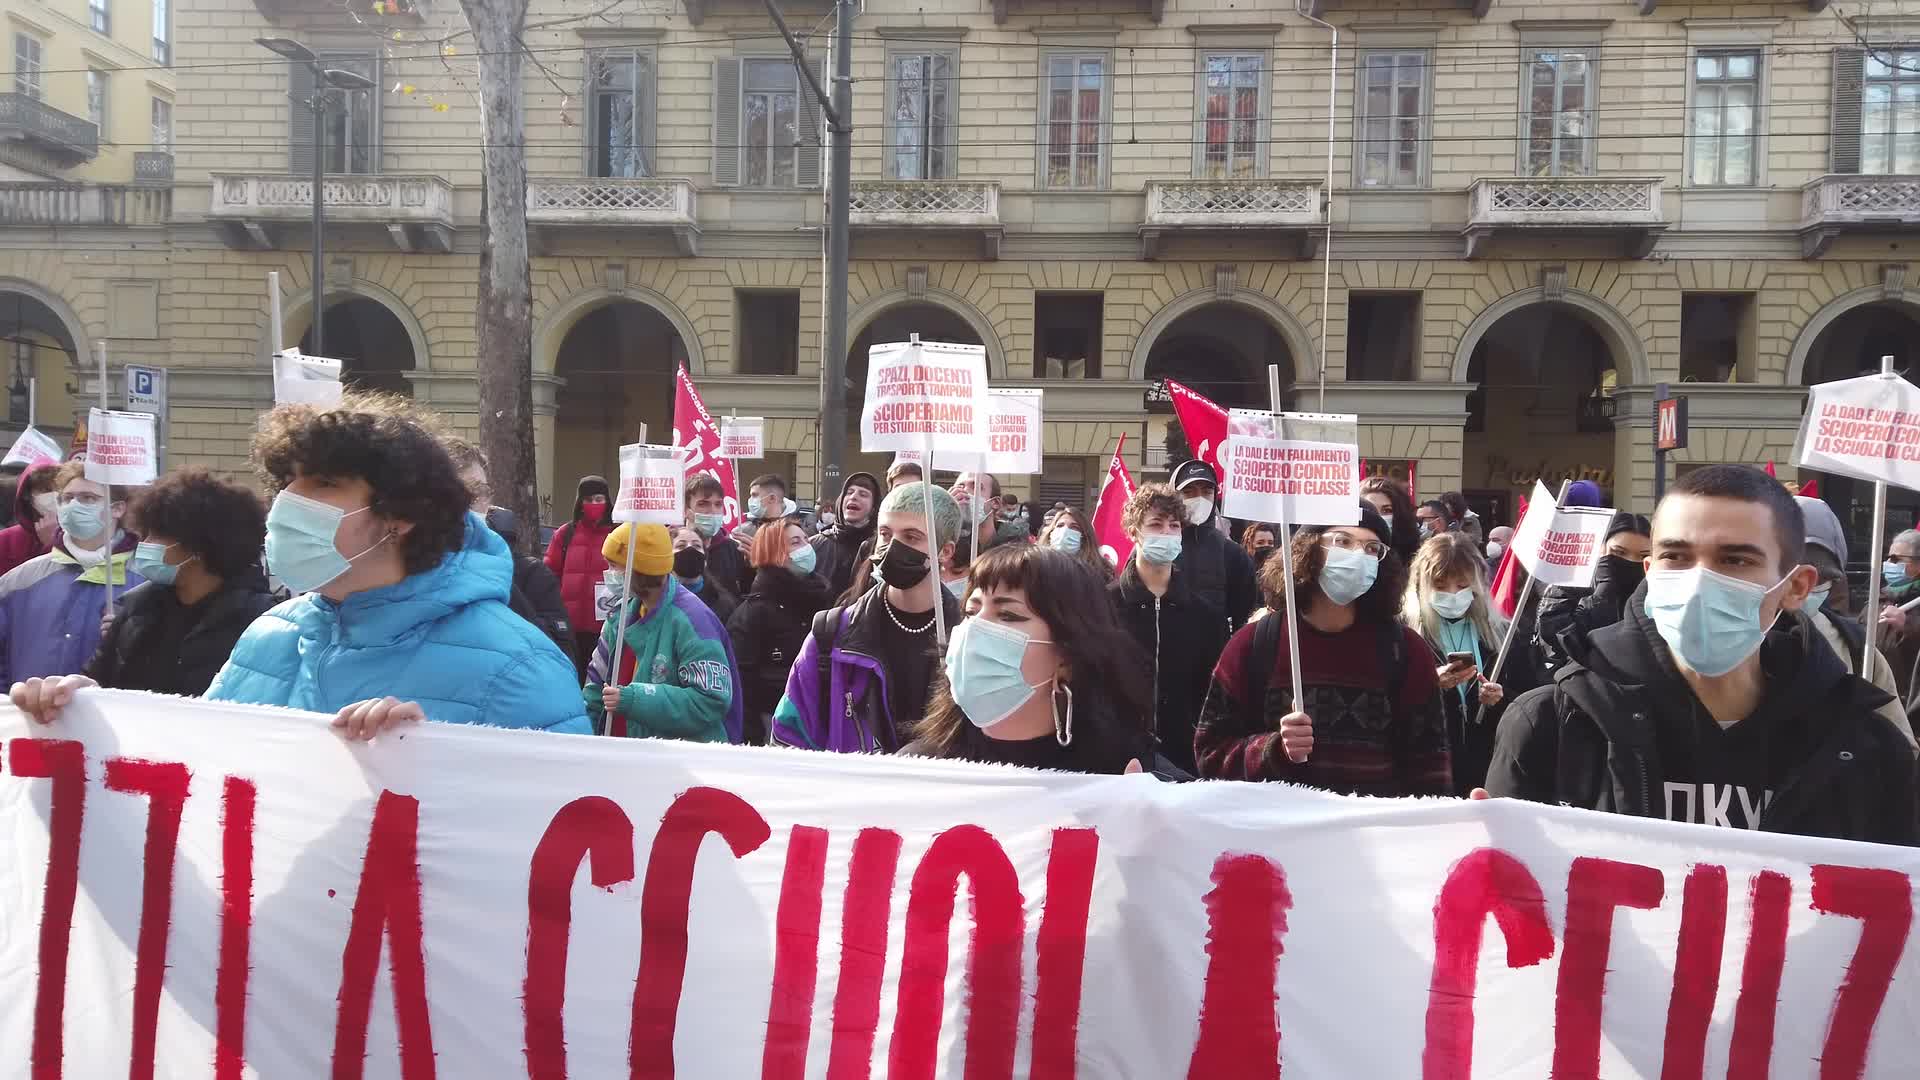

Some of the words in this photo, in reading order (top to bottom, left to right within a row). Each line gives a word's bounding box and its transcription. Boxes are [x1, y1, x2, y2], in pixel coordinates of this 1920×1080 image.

[139, 374, 149, 391] P
[878, 366, 911, 384] SPAZI,
[913, 365, 973, 384] DOCENTI
[928, 384, 973, 398] TAMPONI
[873, 402, 973, 422] SCIOPERIAMO
[1822, 403, 1836, 417] LA
[1839, 406, 1864, 419] DAD
[1875, 409, 1891, 422] UN
[873, 422, 889, 434] PER
[890, 421, 937, 434] STUDIARE
[939, 422, 973, 435] SICURI
[1660, 407, 1677, 441] M
[1819, 419, 1894, 441] SCIOPERO
[989, 434, 1027, 452] ERO!
[1814, 437, 1831, 452] LA
[1832, 439, 1883, 457] SCUOLA
[1885, 444, 1899, 459] DI
[1235, 445, 1244, 457] LA
[1246, 446, 1262, 459] DAD
[1271, 448, 1285, 460] UN
[1288, 449, 1351, 462] FALLIMENTO
[1234, 459, 1291, 478] SCIOPERO
[1294, 463, 1351, 480] CONTRO
[1233, 476, 1243, 490] LA
[1244, 477, 1286, 494] SCUOLA
[1288, 480, 1301, 494] DI
[1304, 481, 1350, 495] CLASSE
[1553, 532, 1565, 542] IN
[1566, 533, 1595, 543] PIAZZA
[1546, 553, 1590, 566] GENERALE
